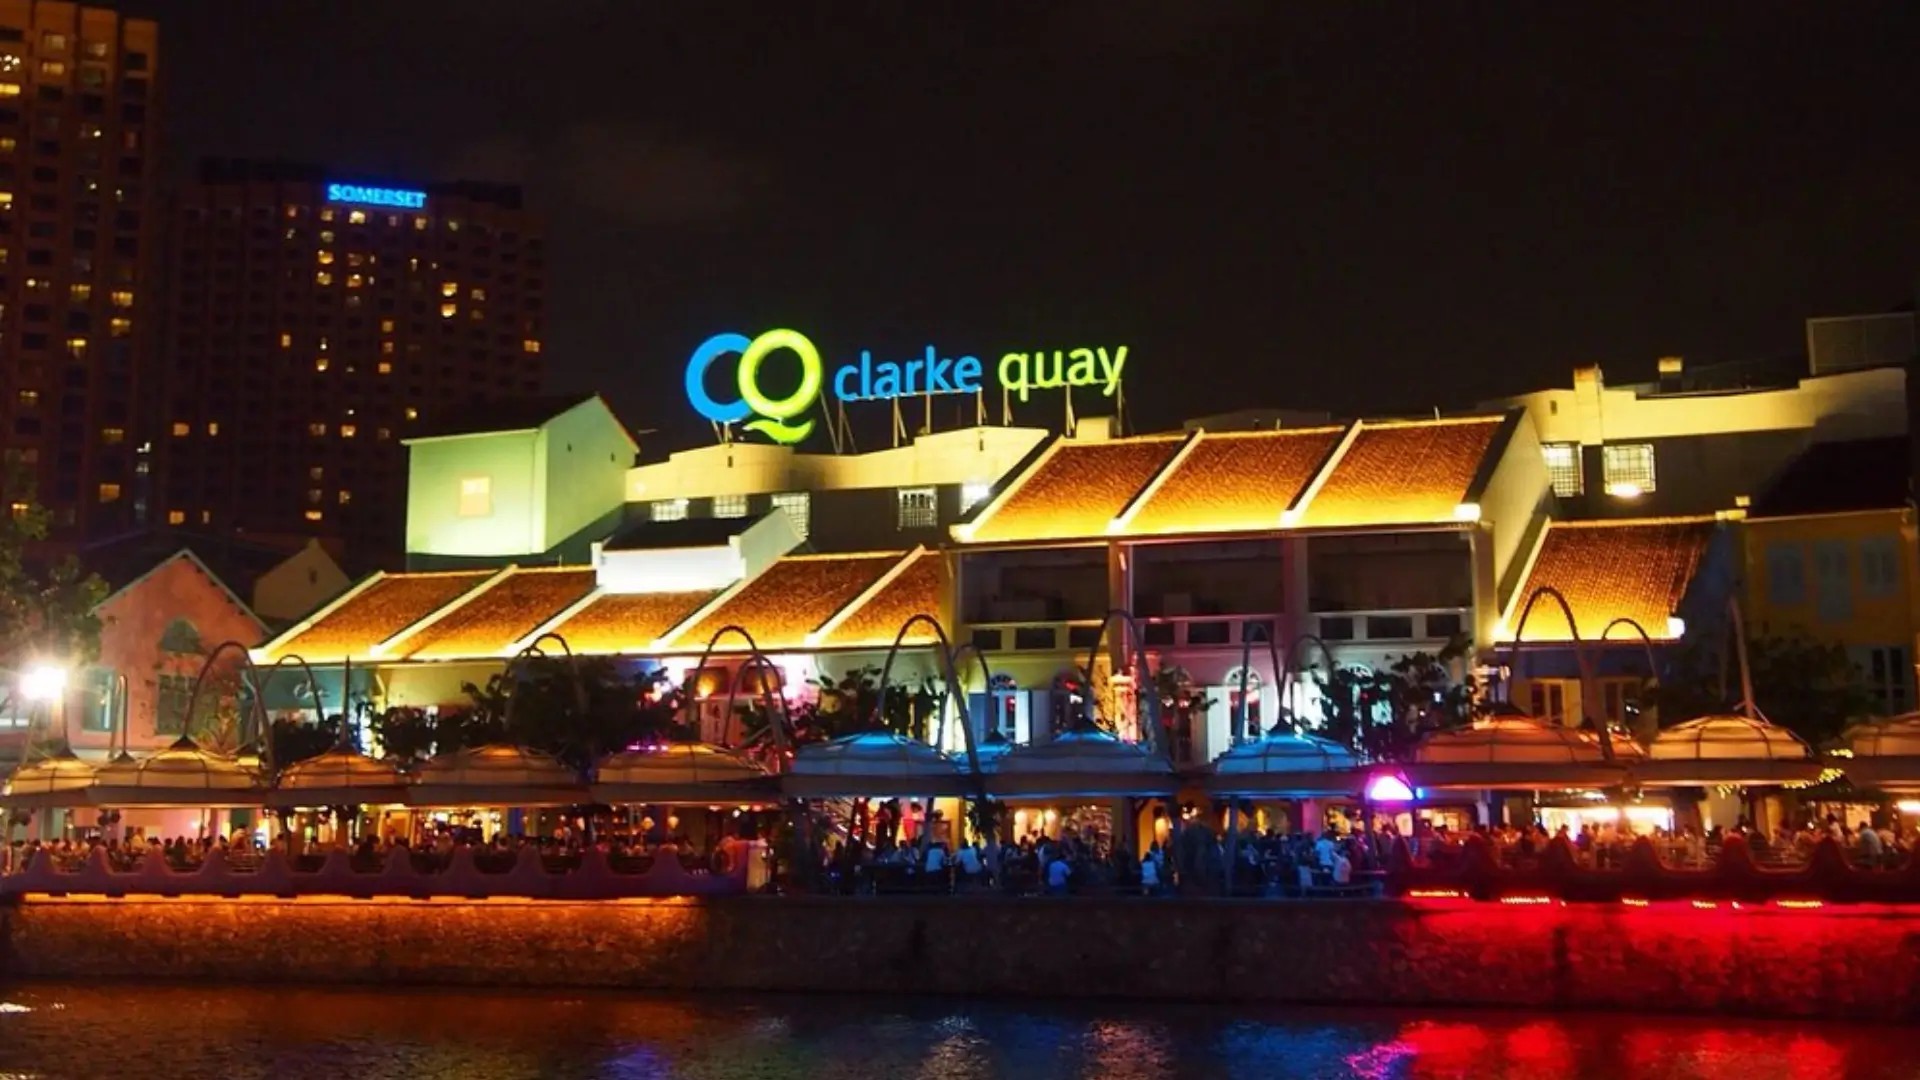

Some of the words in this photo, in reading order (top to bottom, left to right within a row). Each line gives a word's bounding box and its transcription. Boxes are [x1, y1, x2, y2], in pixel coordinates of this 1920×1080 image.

[328, 184, 427, 208] SOMERSET
[834, 345, 982, 402] clarke
[998, 344, 1128, 402] quay
